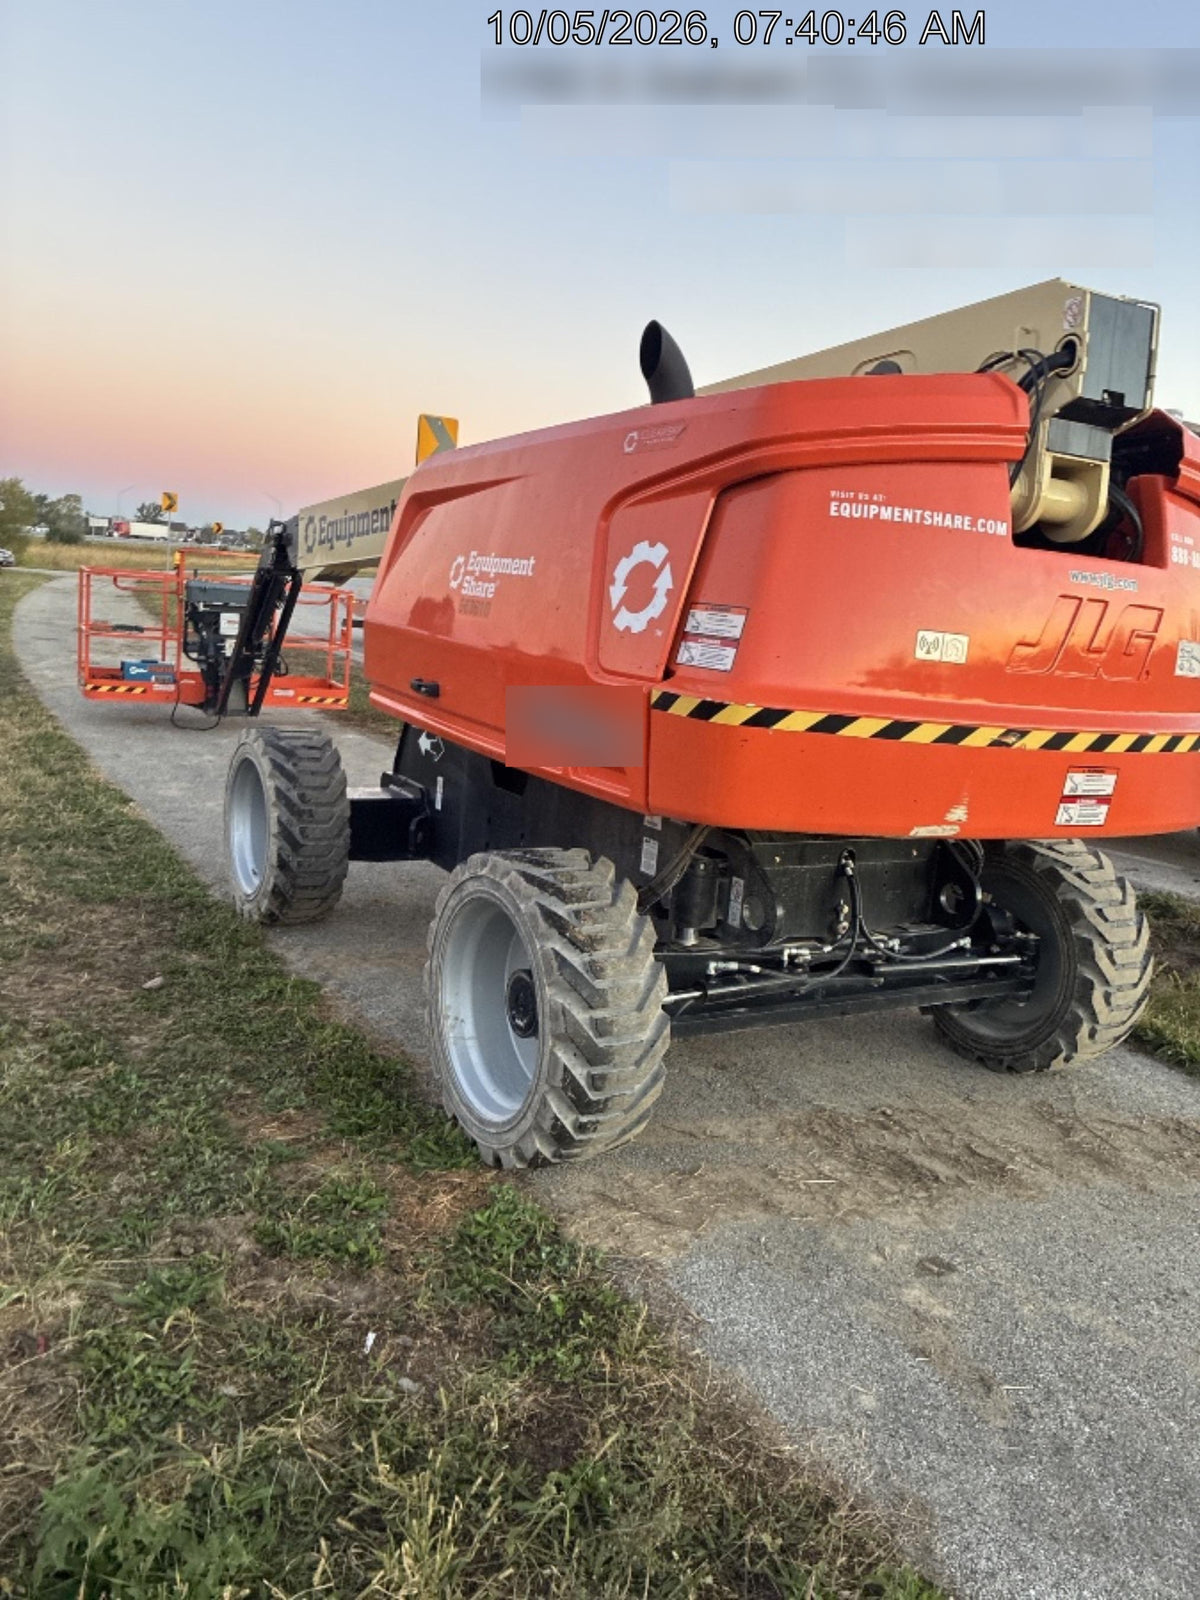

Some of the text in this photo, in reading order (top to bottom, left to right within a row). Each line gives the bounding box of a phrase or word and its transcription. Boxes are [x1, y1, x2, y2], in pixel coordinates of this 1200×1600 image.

[317, 498, 398, 551] Equipment
[829, 501, 1008, 536] EQUIPMENTSHARE.COM
[467, 550, 536, 578] Equipment
[461, 575, 496, 598] Share
[1069, 569, 1138, 592] www.jlg.com
[1005, 594, 1165, 682] JLG
